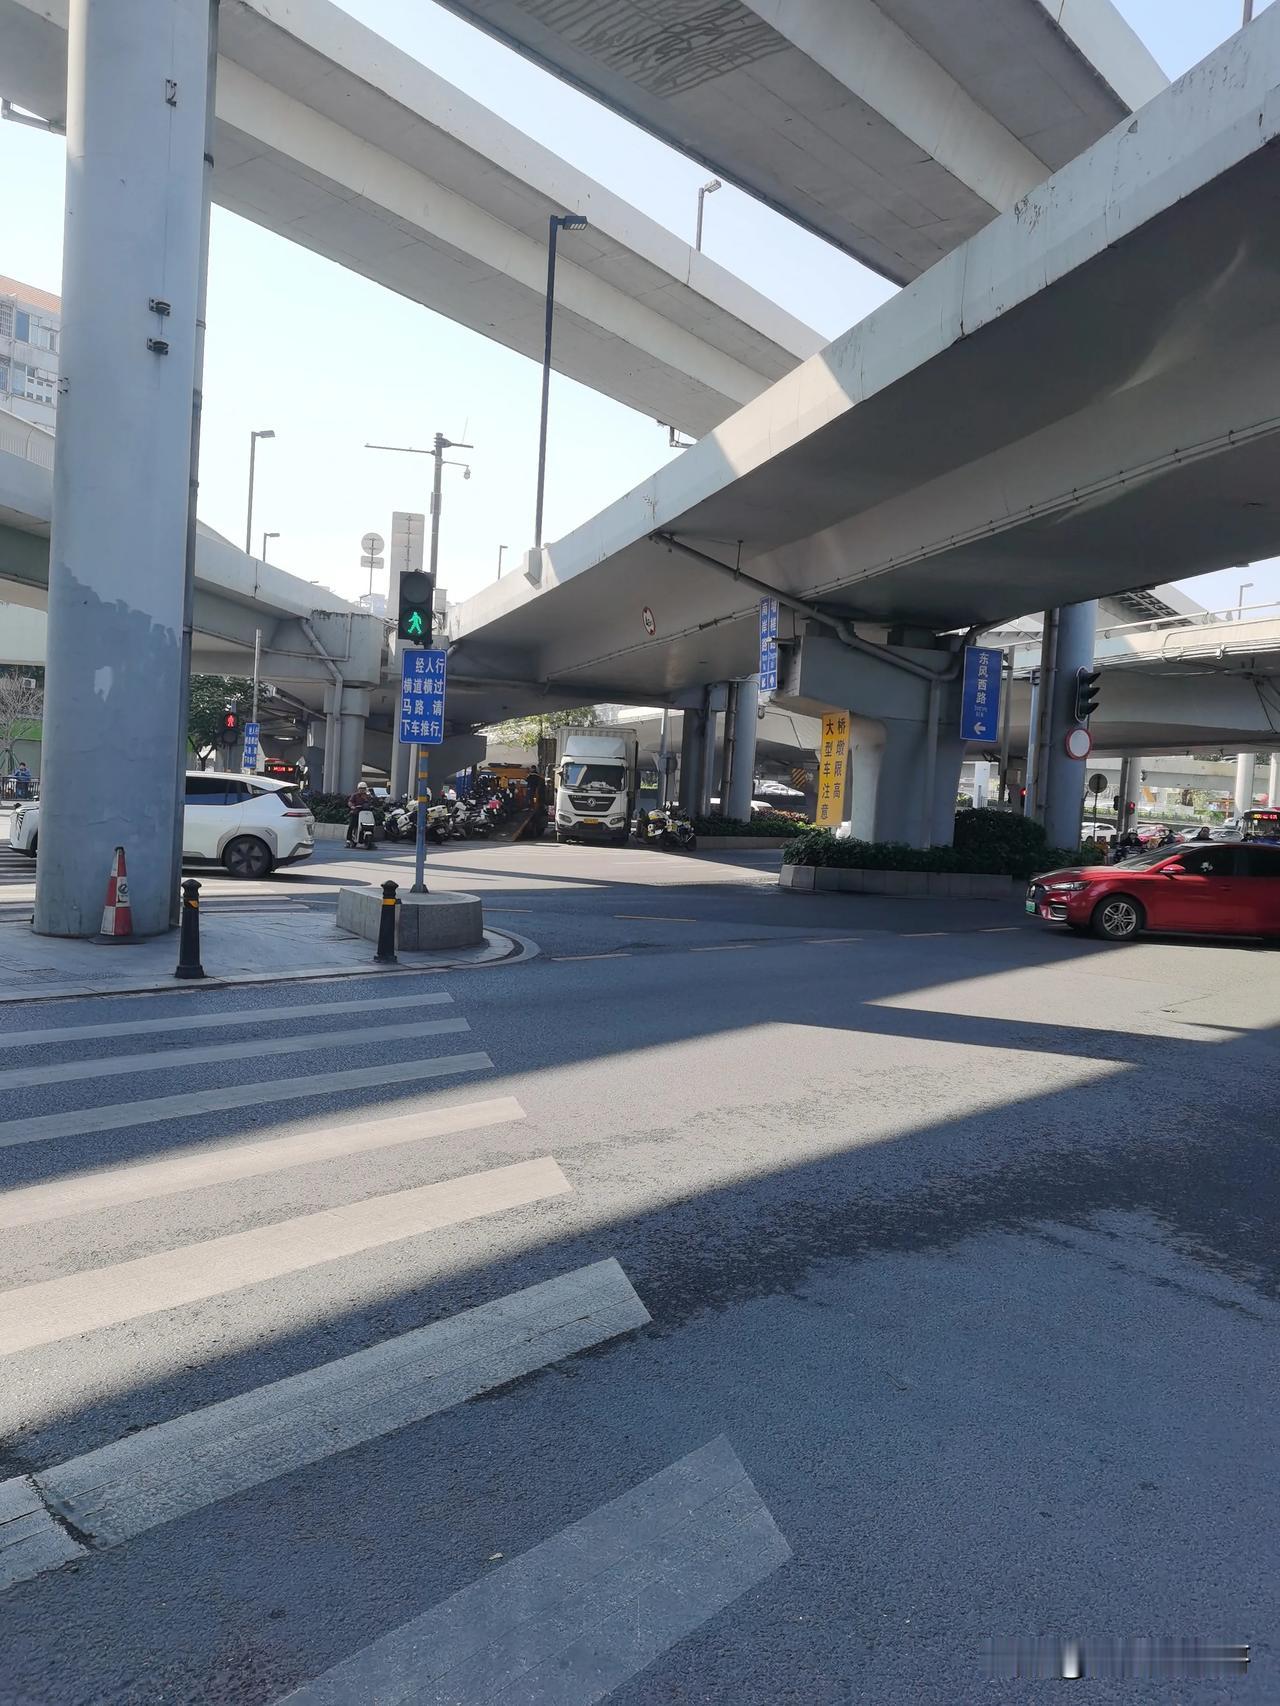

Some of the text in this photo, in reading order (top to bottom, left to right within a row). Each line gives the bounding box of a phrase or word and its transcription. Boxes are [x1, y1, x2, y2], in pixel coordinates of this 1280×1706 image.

[403, 678, 443, 694] 横道横过
[415, 657, 444, 674] 经人行
[976, 652, 989, 705] 东风西路
[820, 719, 834, 819] 大型车注意
[833, 718, 846, 799] 桥墩限高
